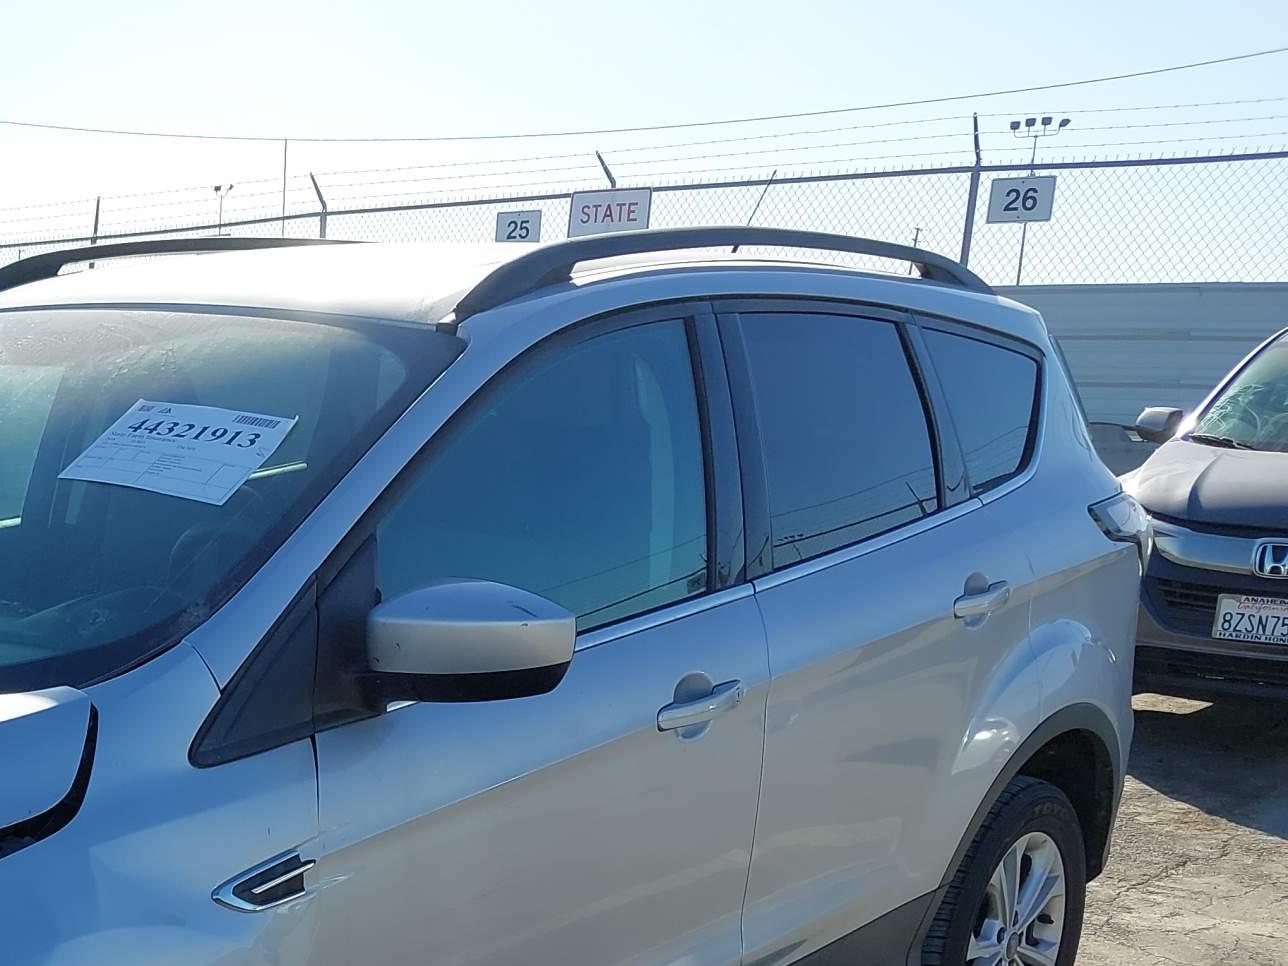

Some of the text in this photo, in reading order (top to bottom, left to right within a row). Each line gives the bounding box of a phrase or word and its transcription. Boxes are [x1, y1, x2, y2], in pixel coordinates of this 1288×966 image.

[1003, 187, 1039, 212] 26
[580, 202, 639, 224] STATE
[506, 219, 530, 240] 25
[127, 418, 262, 448] 44321913
